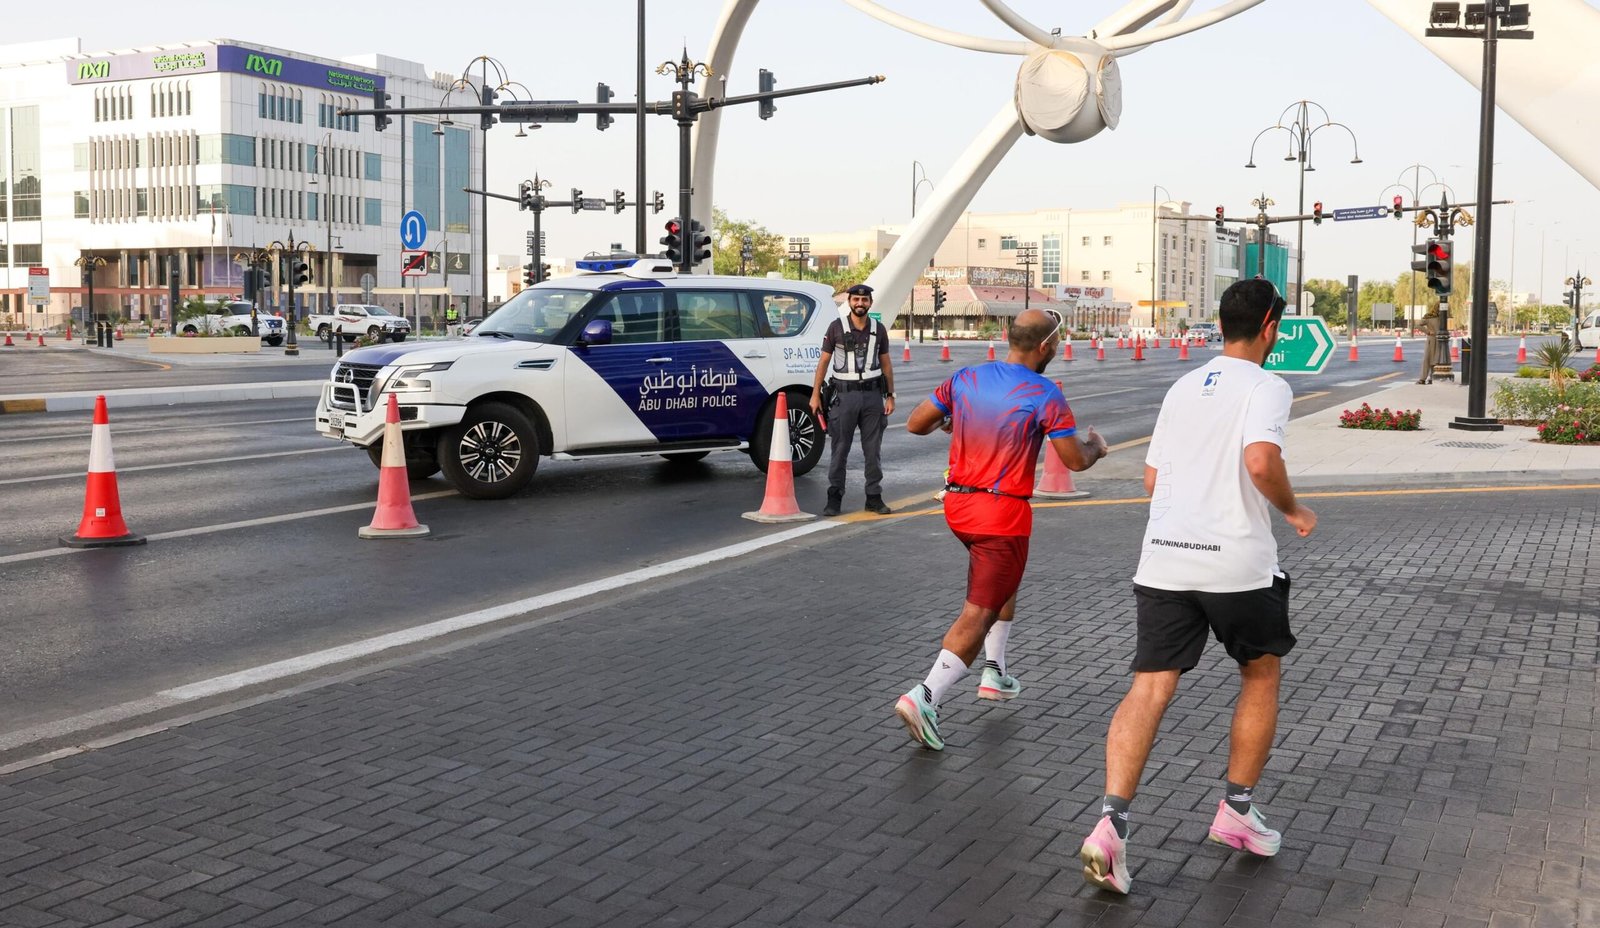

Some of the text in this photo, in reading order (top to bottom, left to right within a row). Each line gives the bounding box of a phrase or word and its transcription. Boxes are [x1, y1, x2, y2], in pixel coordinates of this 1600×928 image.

[77, 61, 110, 79] nxn
[245, 53, 283, 76] nxn
[700, 367, 737, 393] شرطة
[638, 395, 737, 411] ABU DHABI POLICE
[1151, 538, 1222, 552] #RUNINABUDHABI
